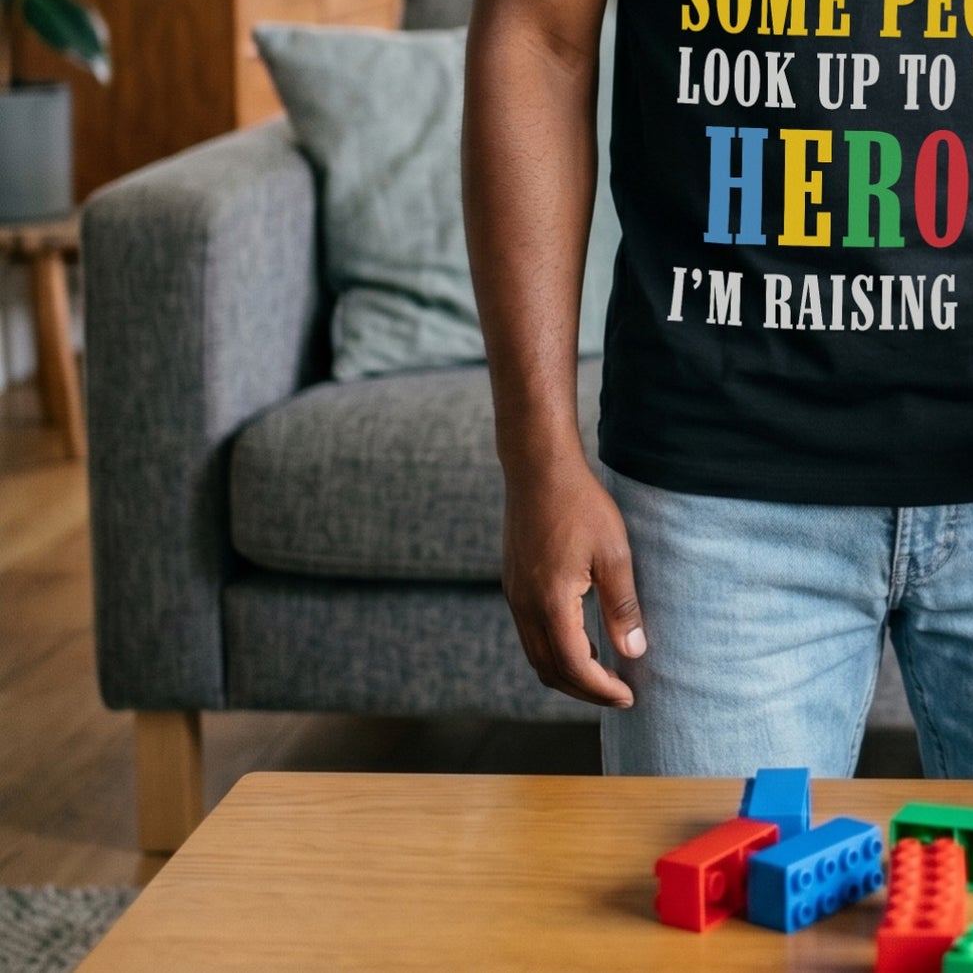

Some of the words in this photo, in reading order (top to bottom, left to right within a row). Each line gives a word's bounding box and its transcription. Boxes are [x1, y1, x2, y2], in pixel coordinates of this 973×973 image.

[677, 46, 796, 108] LOOK
[817, 52, 880, 110] UP
[899, 53, 956, 111] TO
[667, 266, 743, 326] I'M
[763, 273, 958, 331] RAISING
